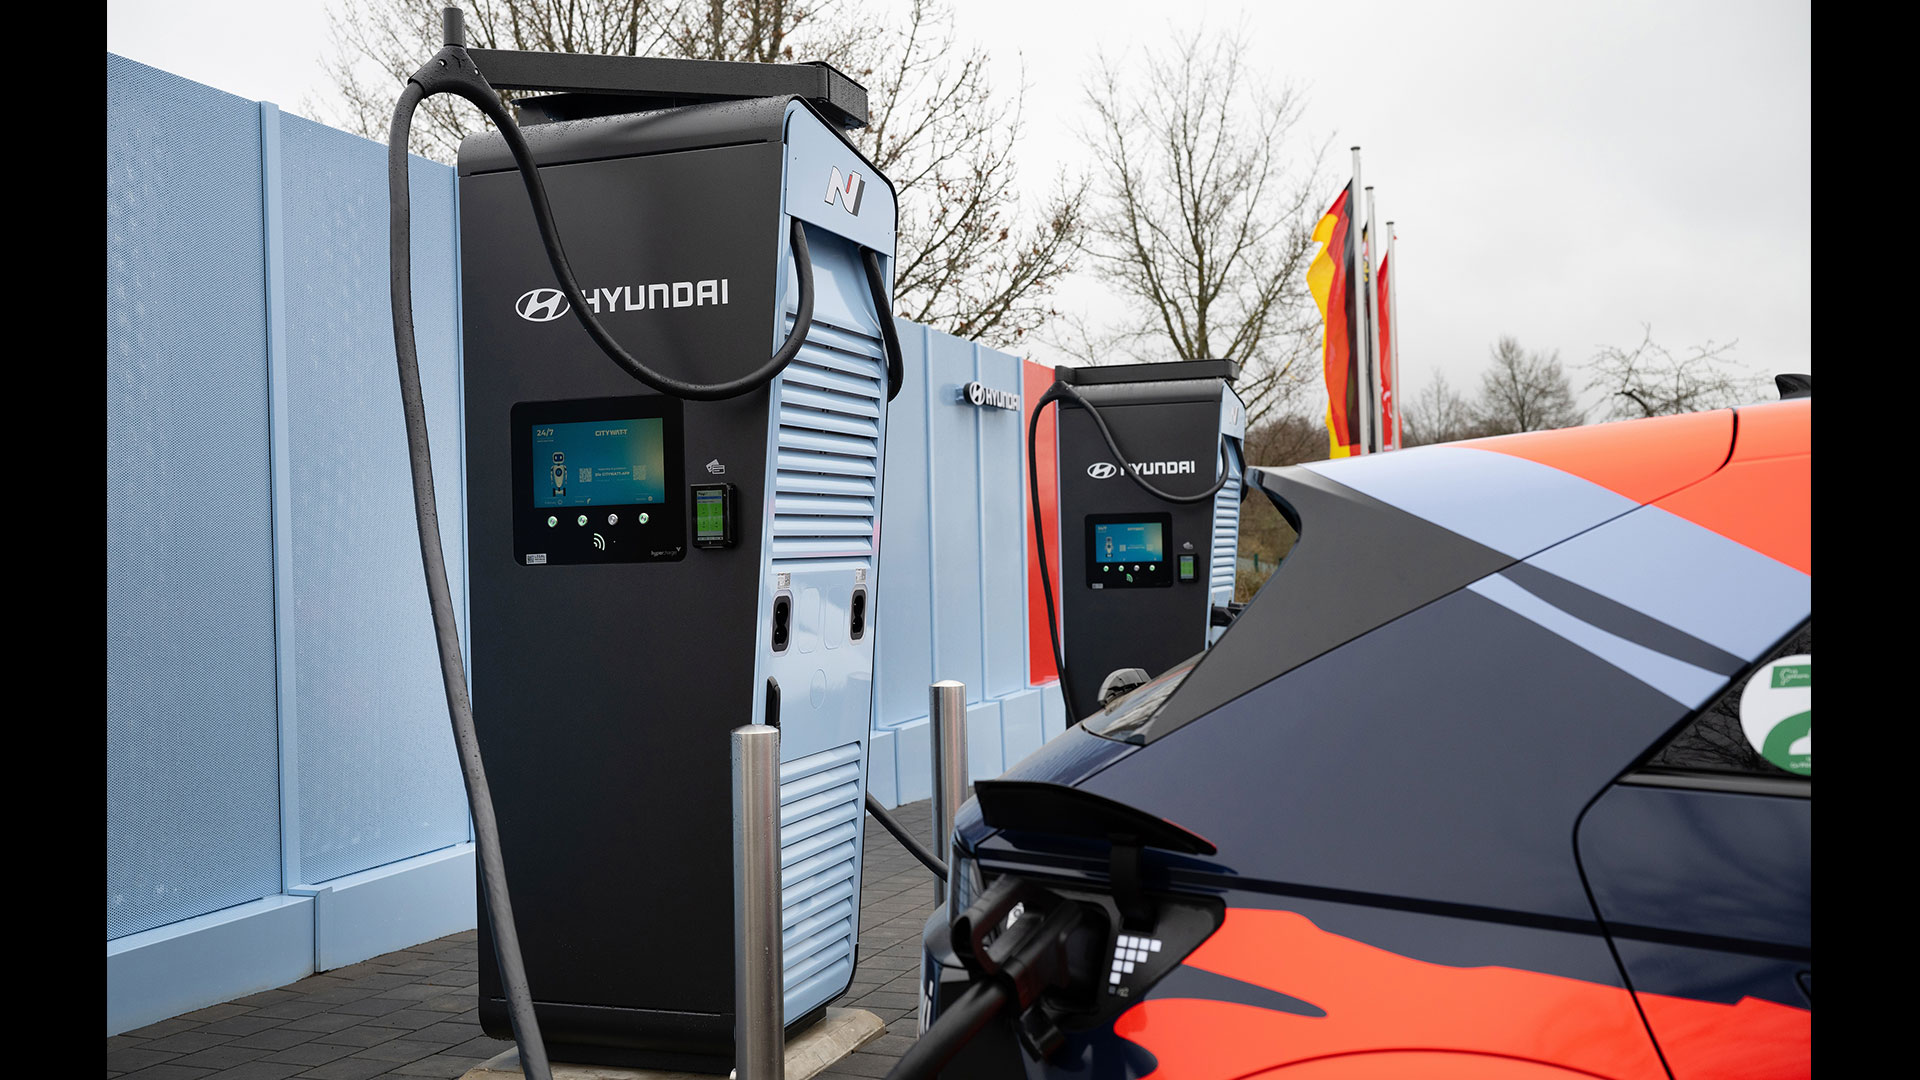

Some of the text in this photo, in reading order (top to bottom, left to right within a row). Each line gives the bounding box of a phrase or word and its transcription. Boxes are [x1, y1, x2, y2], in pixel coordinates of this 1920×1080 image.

[582, 279, 729, 313] HYUNDAI
[536, 428, 554, 438] 24/7
[594, 428, 628, 437] CITYWATT
